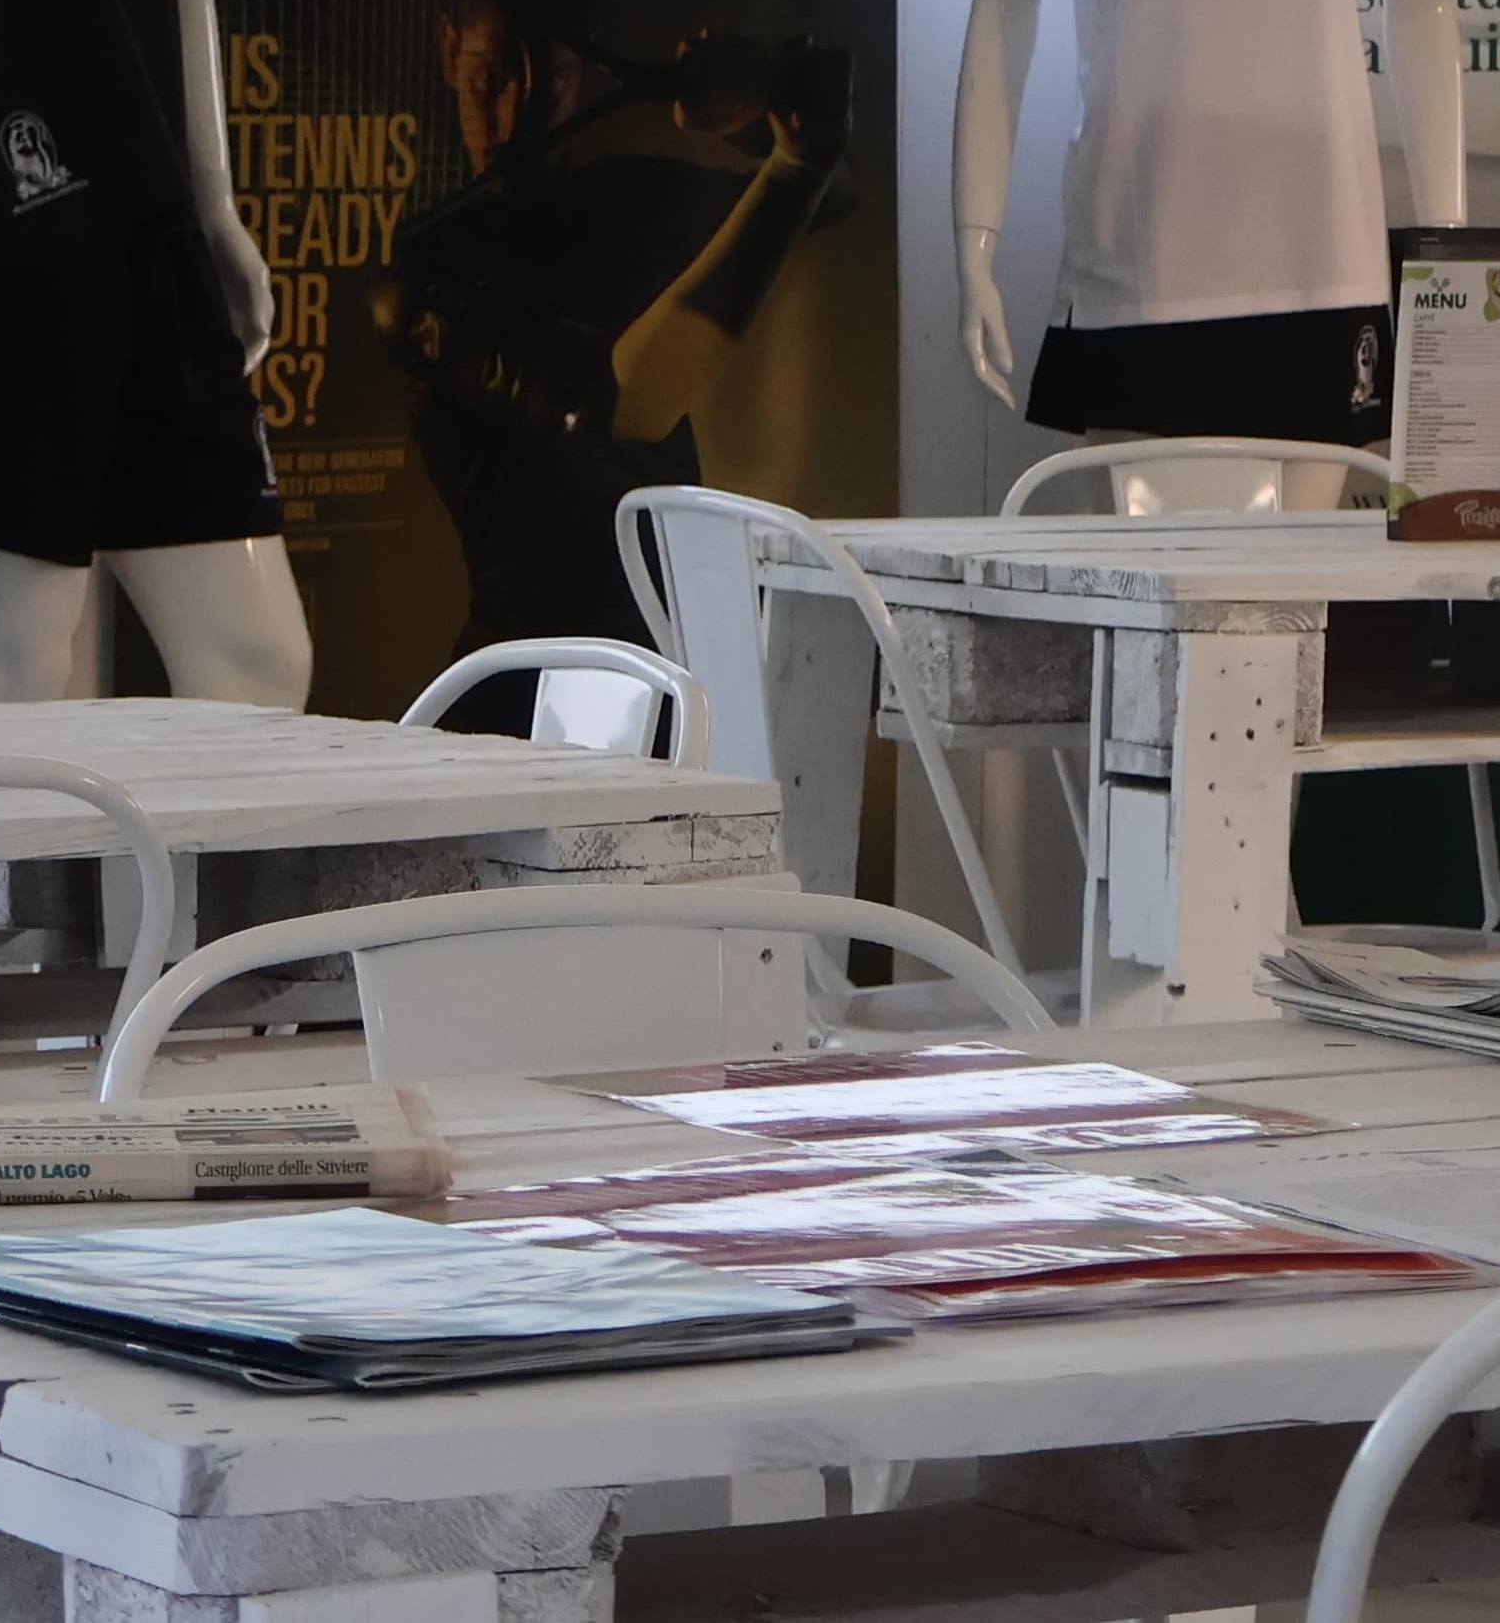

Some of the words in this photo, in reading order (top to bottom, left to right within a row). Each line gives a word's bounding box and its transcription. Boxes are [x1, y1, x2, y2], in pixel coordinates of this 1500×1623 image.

[229, 33, 280, 109] IS
[228, 112, 418, 189] TENNIS
[269, 270, 330, 348] OR
[1414, 292, 1468, 310] MENU
[250, 351, 326, 430] S?
[41, 1162, 92, 1179] LAGO
[194, 1160, 275, 1183] Castiglione
[277, 1160, 313, 1177] delle
